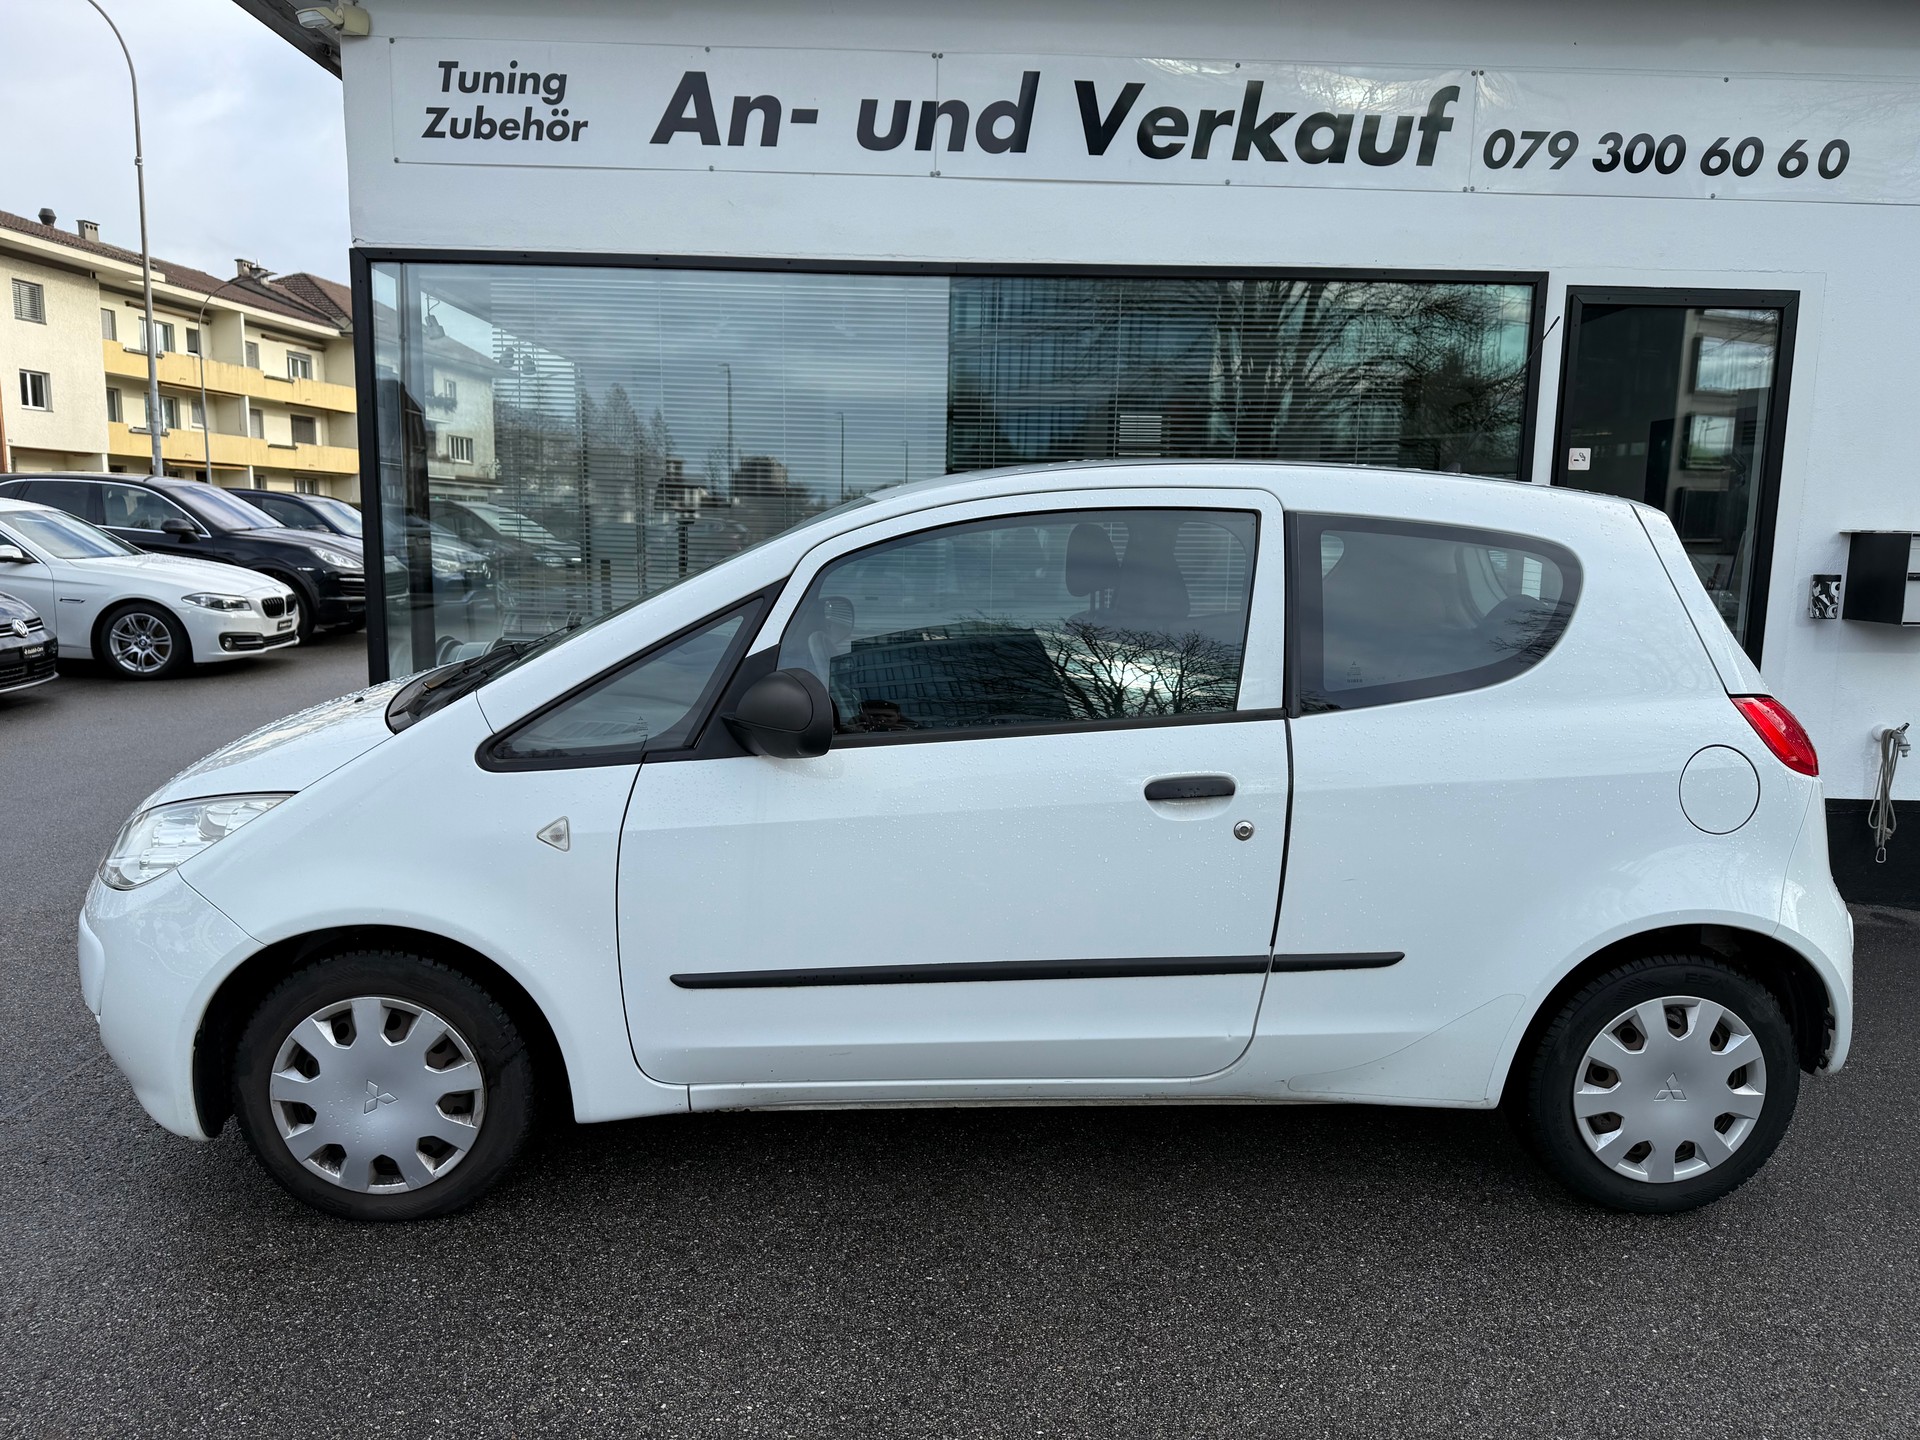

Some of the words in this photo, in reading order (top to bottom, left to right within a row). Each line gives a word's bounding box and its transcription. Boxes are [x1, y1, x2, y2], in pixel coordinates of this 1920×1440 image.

[438, 60, 568, 105] Tuning
[421, 104, 589, 142] Zubehör
[649, 70, 819, 148] An-
[856, 70, 1041, 155] und
[1073, 79, 1461, 167] Verkauf
[1482, 128, 1580, 170] 079
[1591, 131, 1687, 175] 300
[1699, 136, 1765, 178] 60
[1777, 138, 1851, 180] 60
